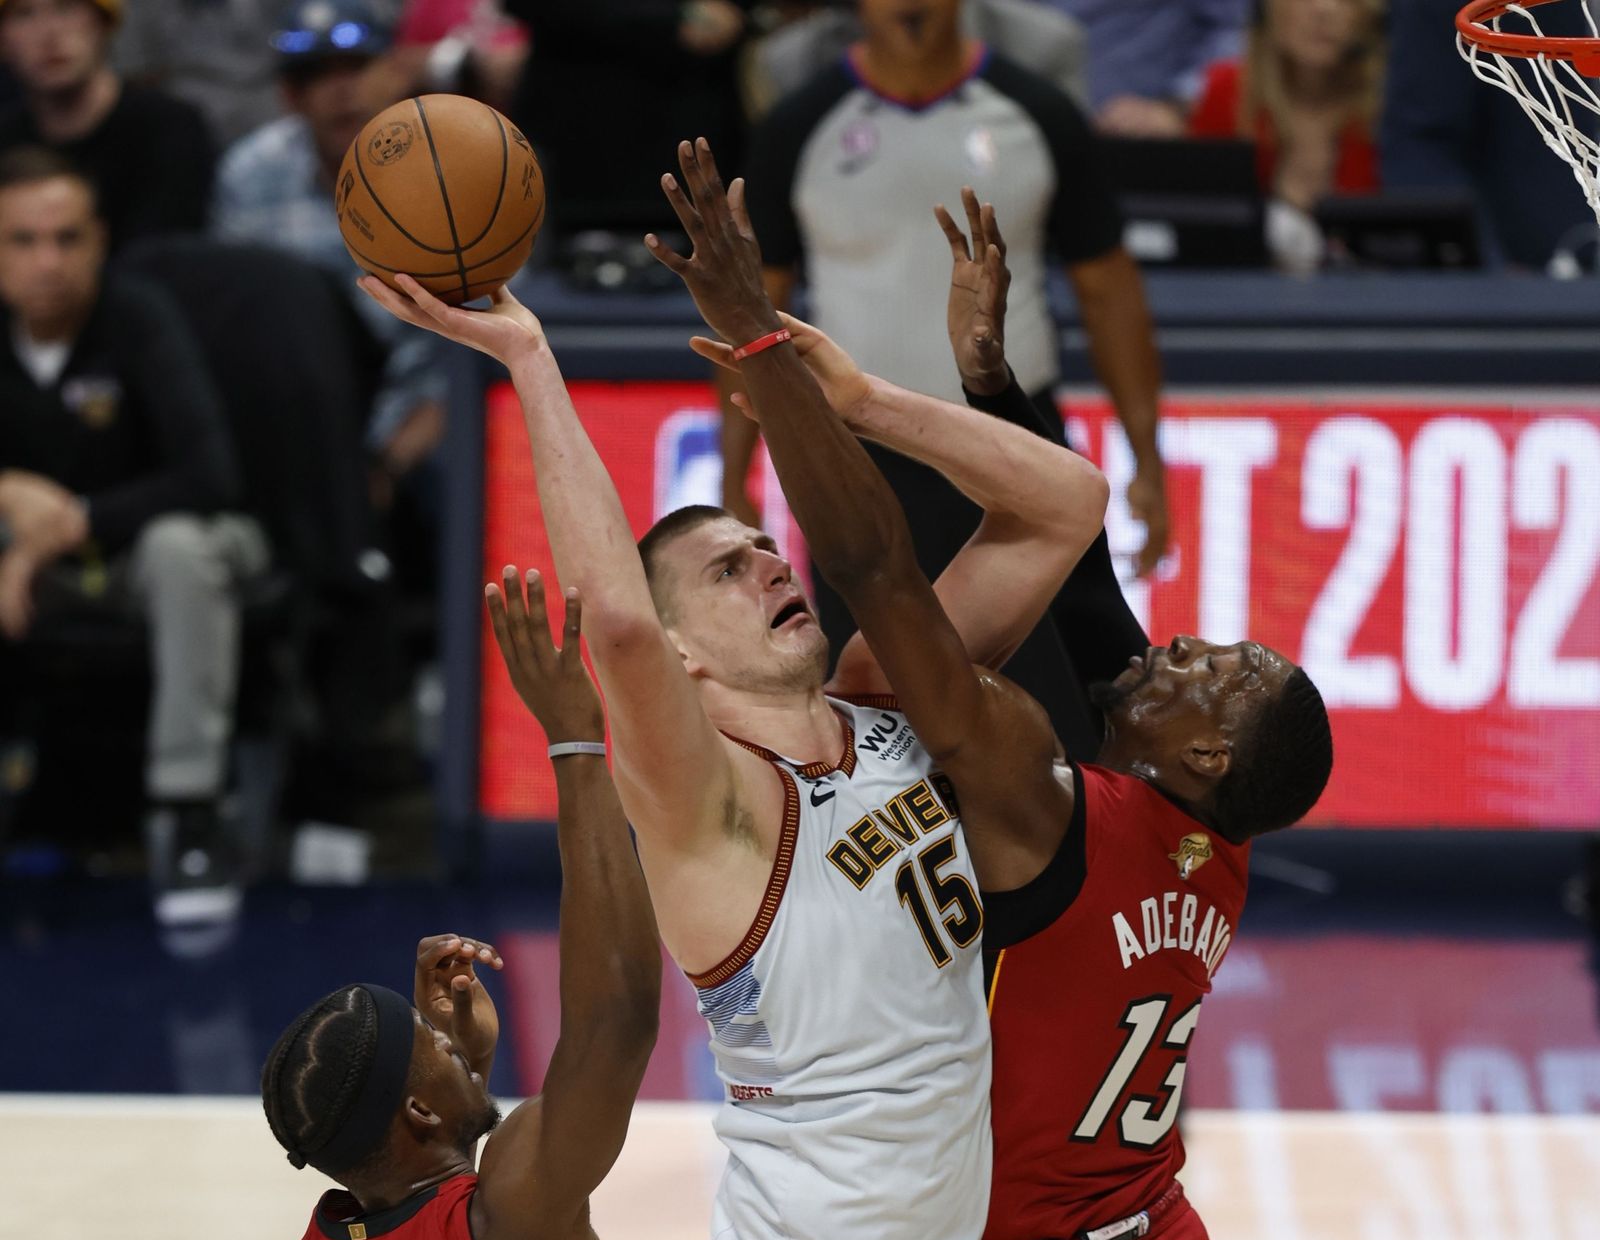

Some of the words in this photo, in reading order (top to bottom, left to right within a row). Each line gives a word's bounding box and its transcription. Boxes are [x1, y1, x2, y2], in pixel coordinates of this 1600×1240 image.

[858, 712, 899, 753] WU
[878, 724, 912, 762] Western
[891, 735, 916, 762] Union
[895, 833, 984, 969] 15
[1067, 992, 1203, 1151] 13
